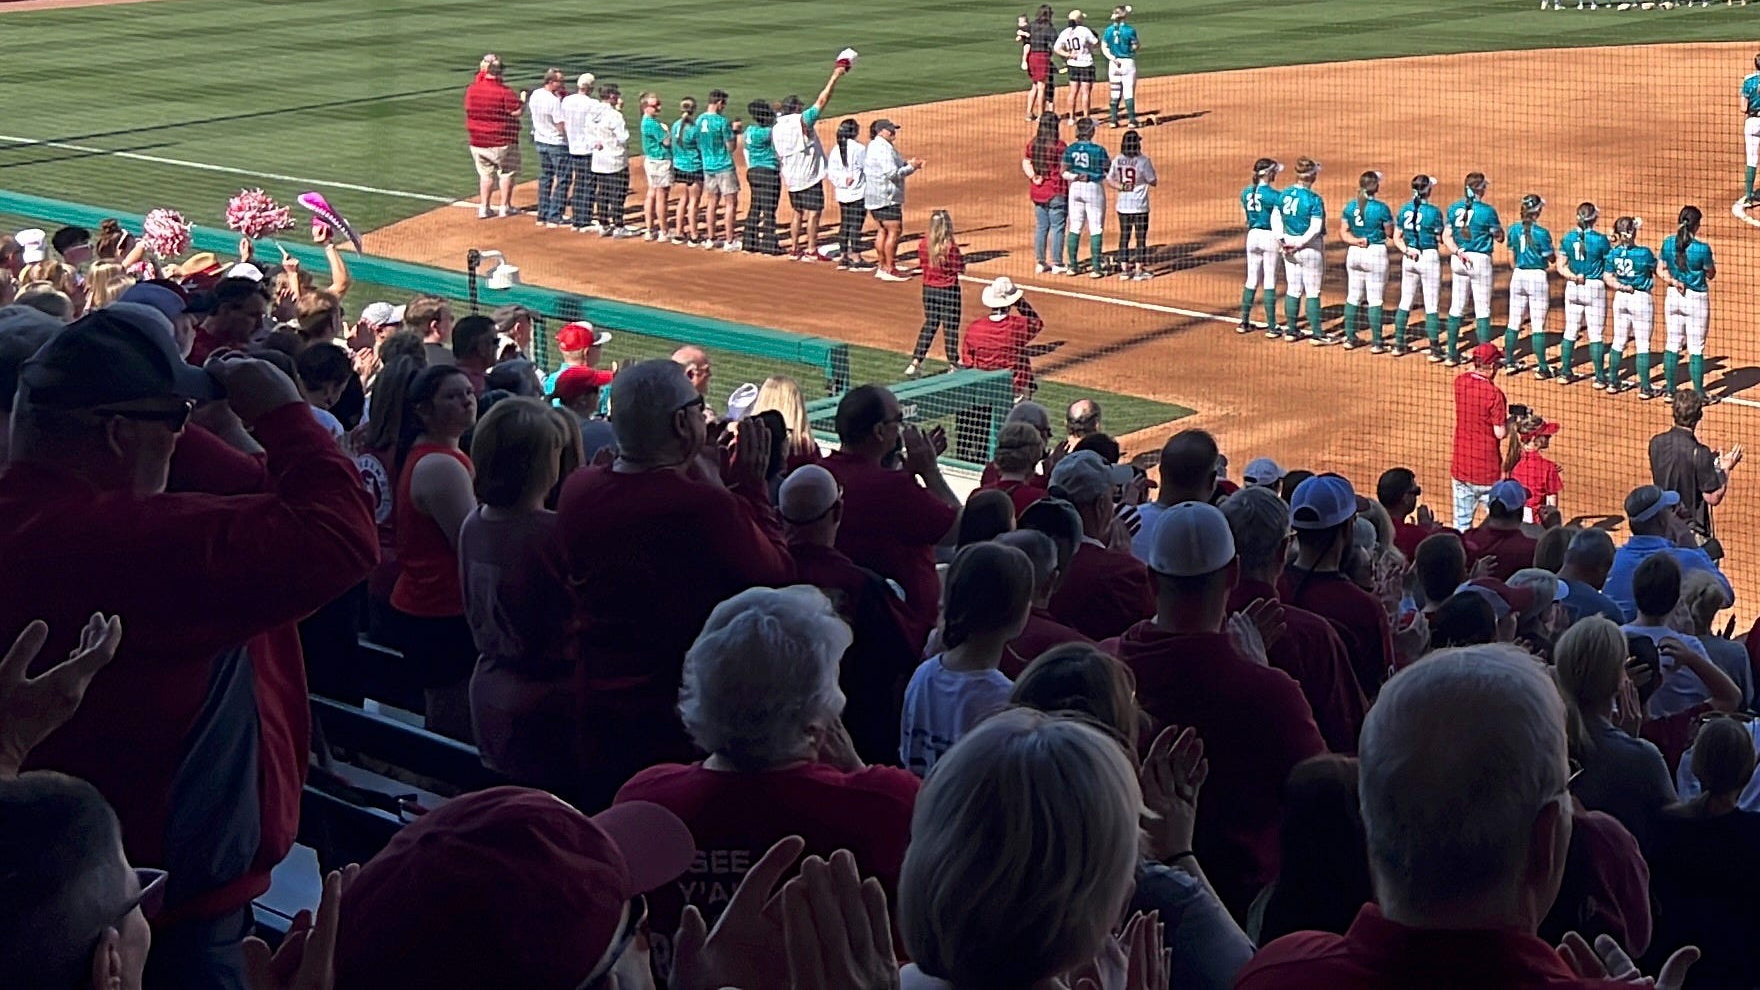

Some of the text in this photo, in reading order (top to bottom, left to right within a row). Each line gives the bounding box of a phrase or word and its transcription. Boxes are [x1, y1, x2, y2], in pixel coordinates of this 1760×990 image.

[1067, 36, 1081, 52] 10
[1071, 152, 1090, 168] 29
[1246, 192, 1263, 212] 25
[1282, 195, 1300, 217] 24
[1614, 257, 1636, 277] 32
[689, 849, 751, 875] SEE
[677, 881, 739, 905] Y'A
